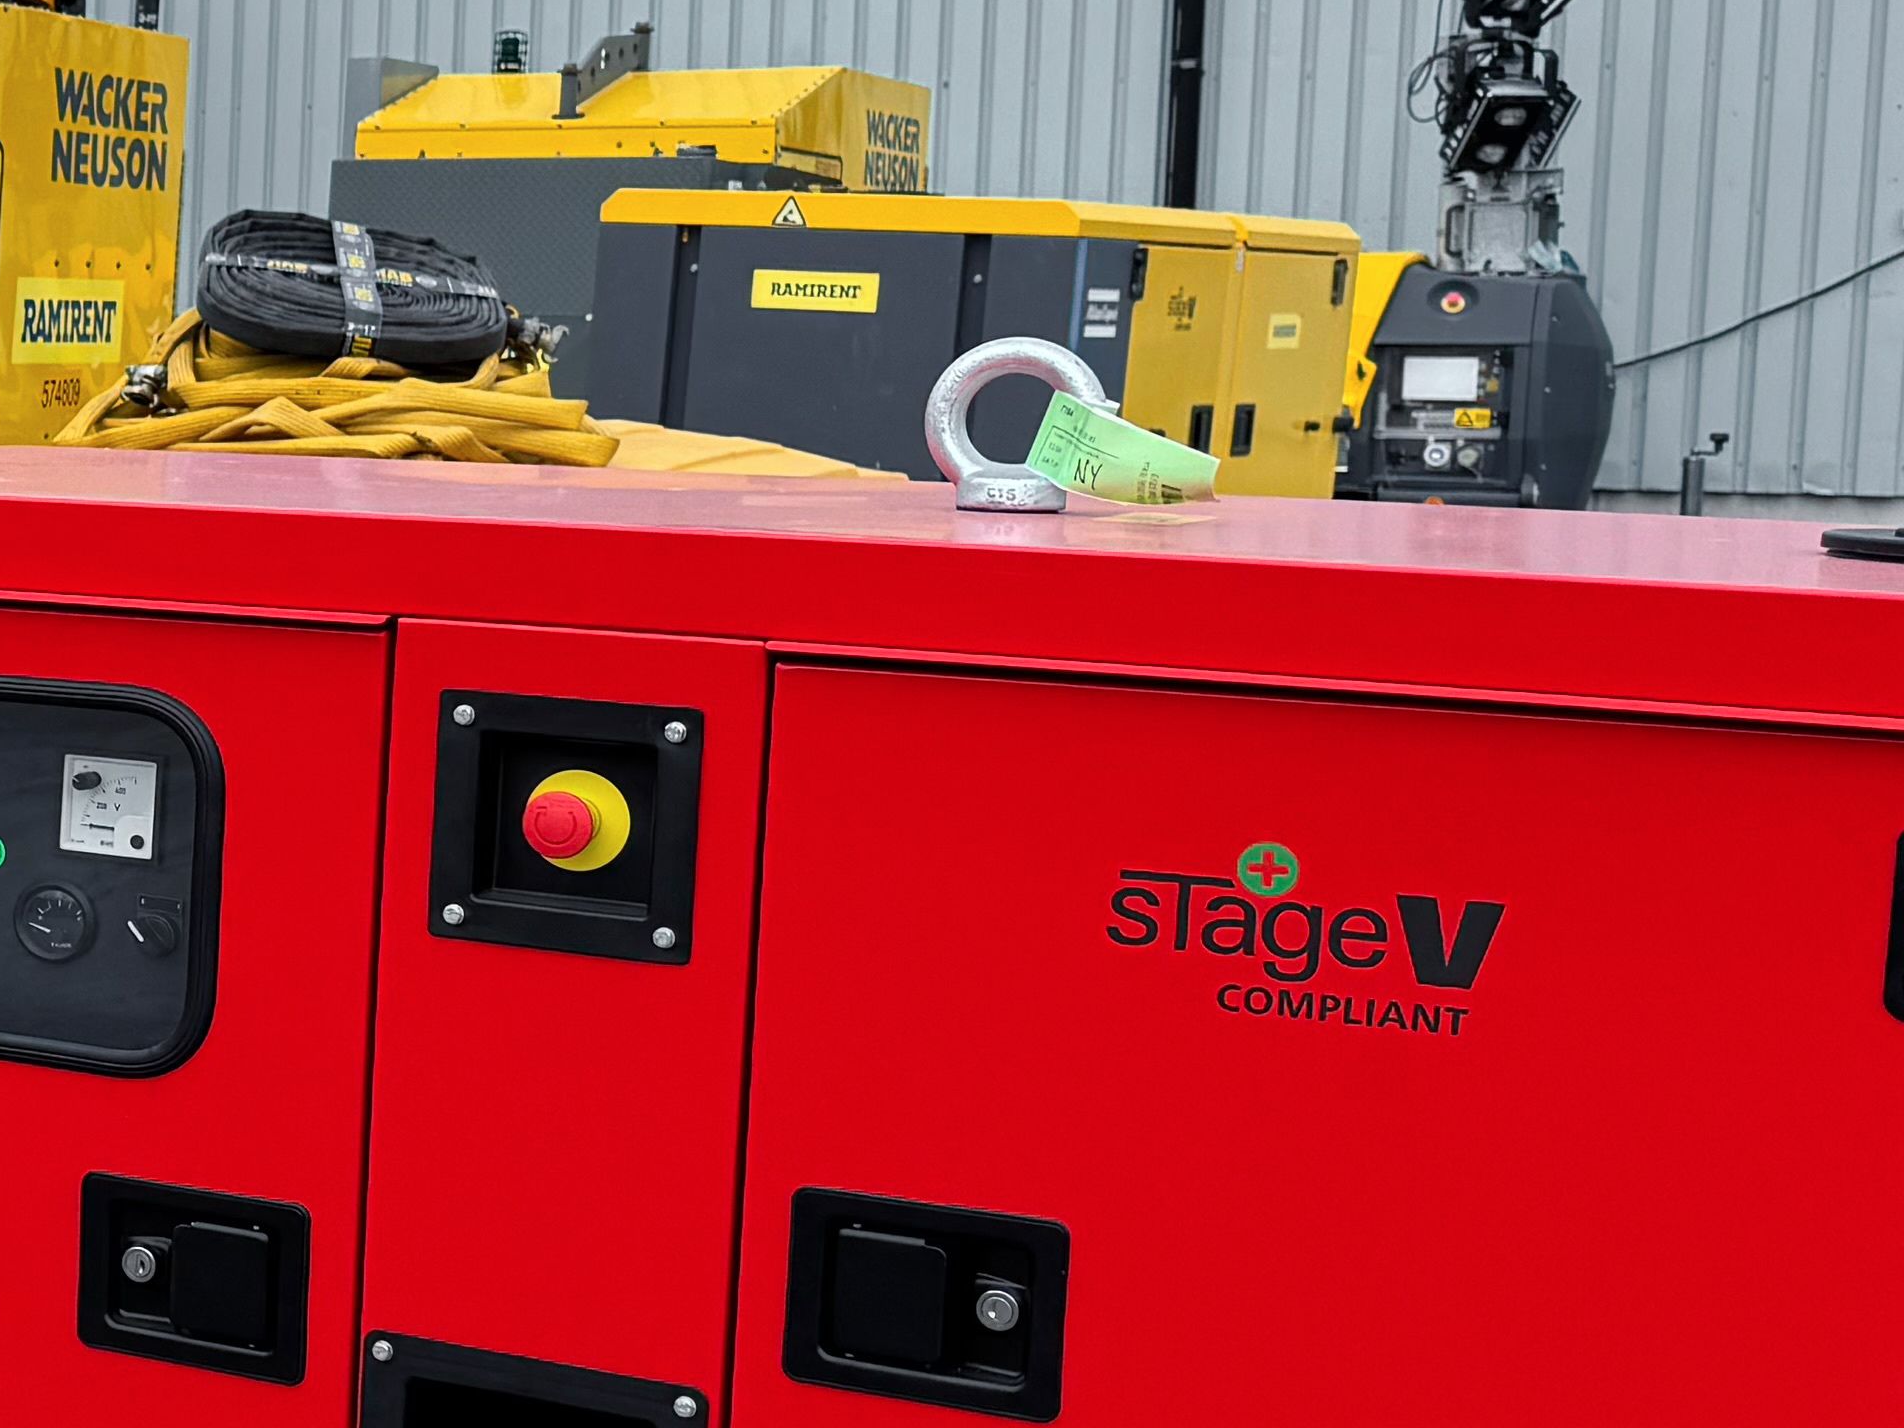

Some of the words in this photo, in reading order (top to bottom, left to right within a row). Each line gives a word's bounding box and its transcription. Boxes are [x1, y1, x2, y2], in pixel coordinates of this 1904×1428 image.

[54, 66, 168, 134] WACKER
[866, 108, 920, 154] WACKER
[51, 128, 168, 191] NEUSON
[863, 149, 919, 191] NEUSON
[771, 282, 862, 298] RAMIRENT
[21, 299, 117, 343] RAMIRENT
[1073, 458, 1103, 491] NY
[1215, 982, 1470, 1038] COMPLIANT
